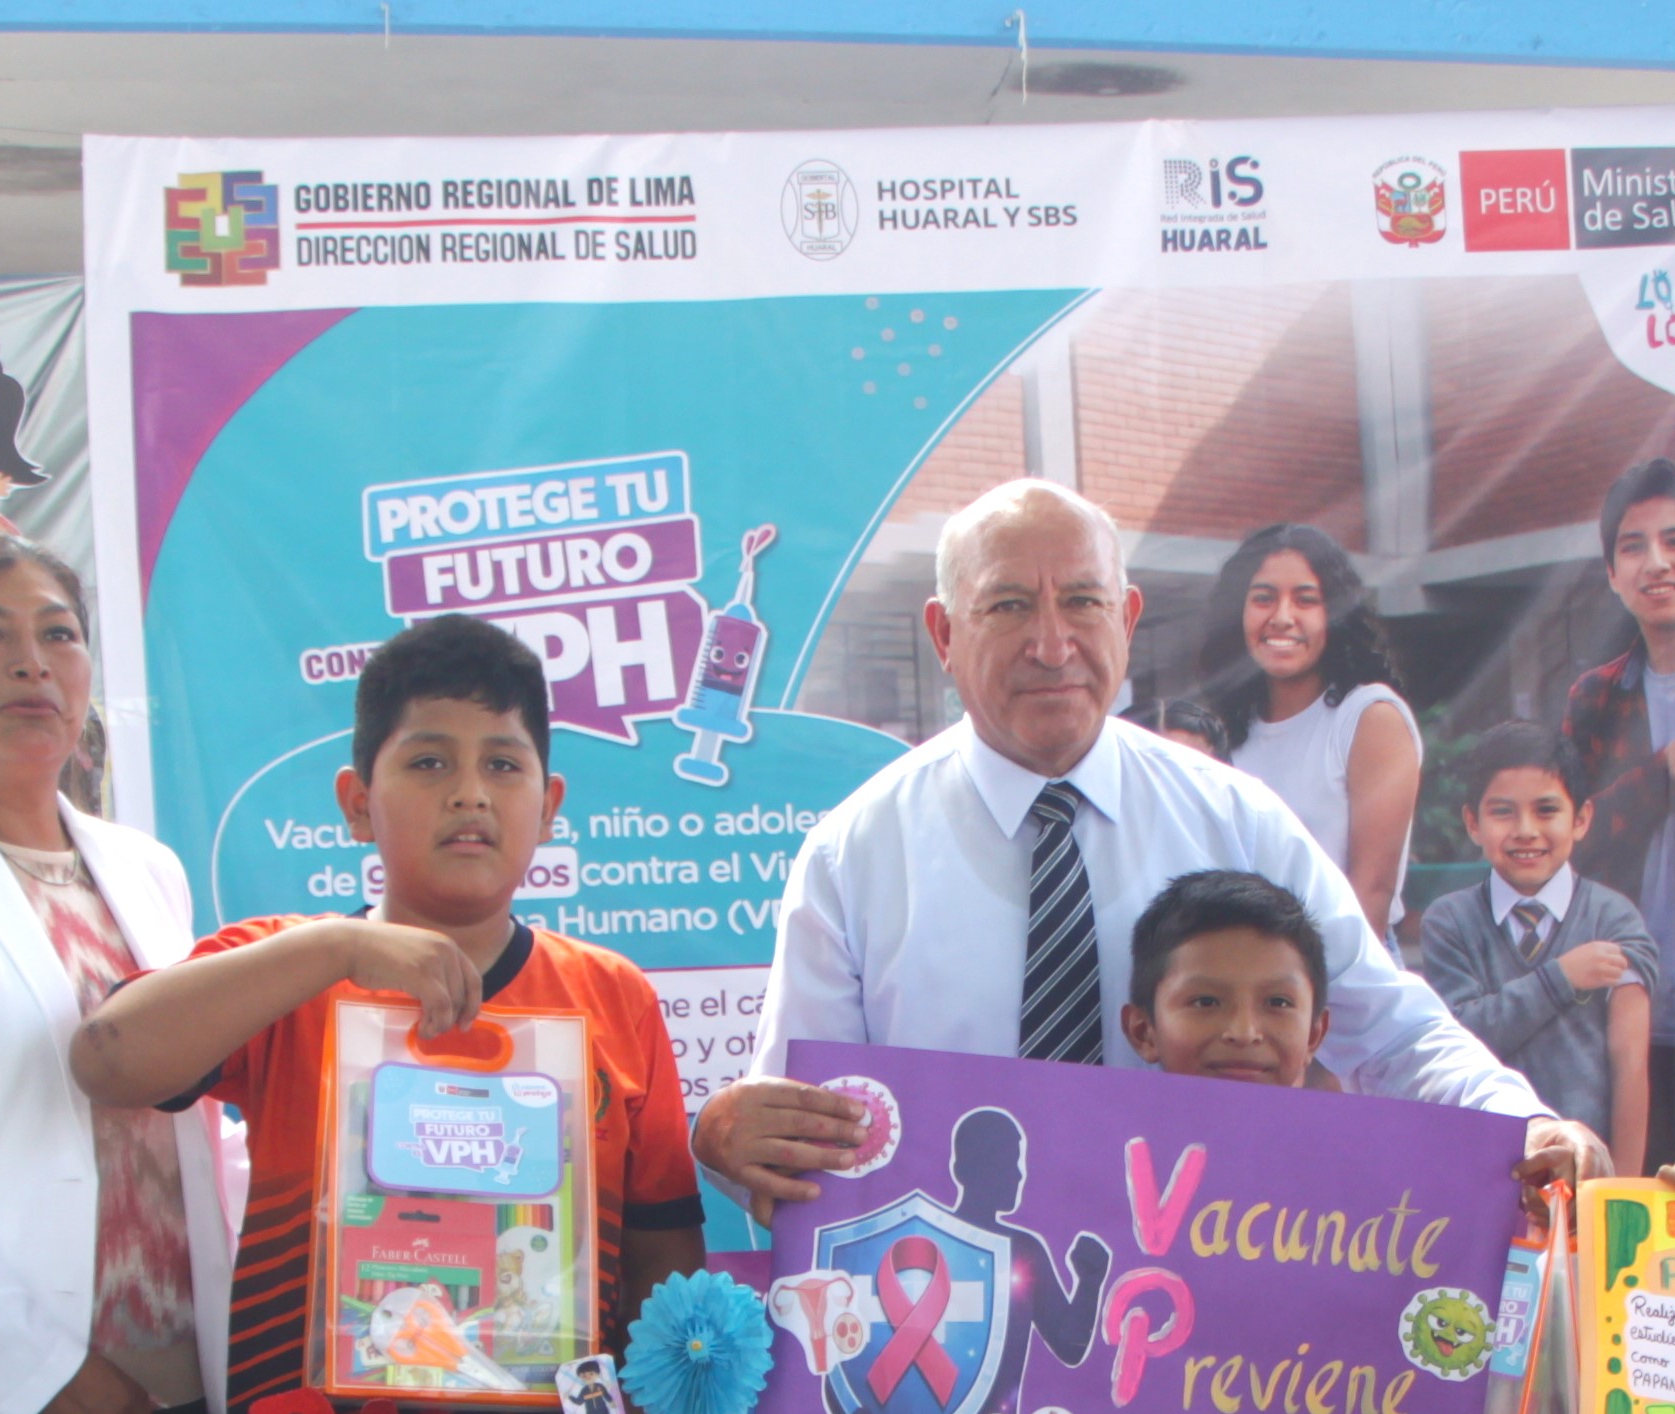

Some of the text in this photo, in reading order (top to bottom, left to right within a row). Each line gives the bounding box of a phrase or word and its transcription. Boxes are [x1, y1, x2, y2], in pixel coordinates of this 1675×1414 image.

[295, 176, 695, 213] GOBIERNO REGIONAL DE LIMA
[878, 178, 1019, 201] HOSPITAL
[1480, 180, 1557, 214] PERÚ
[879, 205, 1078, 230] HUARAL Y SBS
[1583, 203, 1622, 231] de
[297, 229, 696, 267] DIRECCION REGIONAL DE SALUD
[1161, 227, 1268, 253] HUARAL
[378, 468, 670, 545] PROTEGE TU
[421, 532, 653, 603] FUTURO
[489, 599, 681, 712] PH
[589, 808, 670, 840] niño
[679, 814, 702, 838] o
[308, 855, 740, 898] de contra el
[557, 905, 716, 937] Humano
[700, 989, 725, 1017] el
[696, 1037, 715, 1064] y
[425, 1124, 490, 1137] FUTURO
[426, 1140, 498, 1165] VPH
[1124, 1136, 1452, 1280] Vacunate
[371, 1245, 469, 1266] FABER-CASTELL
[1630, 1350, 1671, 1367] como
